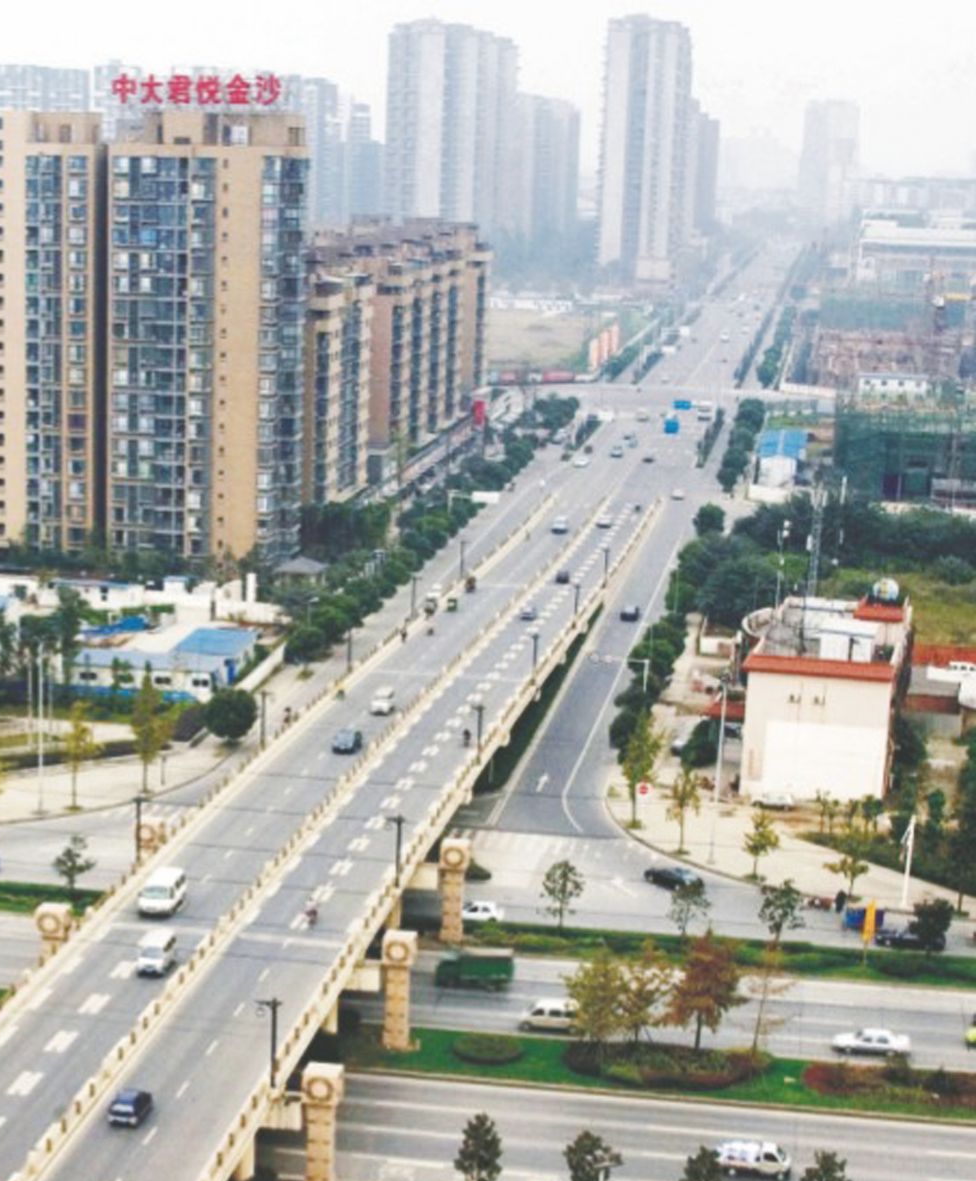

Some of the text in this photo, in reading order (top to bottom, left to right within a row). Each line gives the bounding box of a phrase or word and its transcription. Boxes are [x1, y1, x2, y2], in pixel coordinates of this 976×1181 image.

[111, 73, 282, 105] 中大君悦金沙
